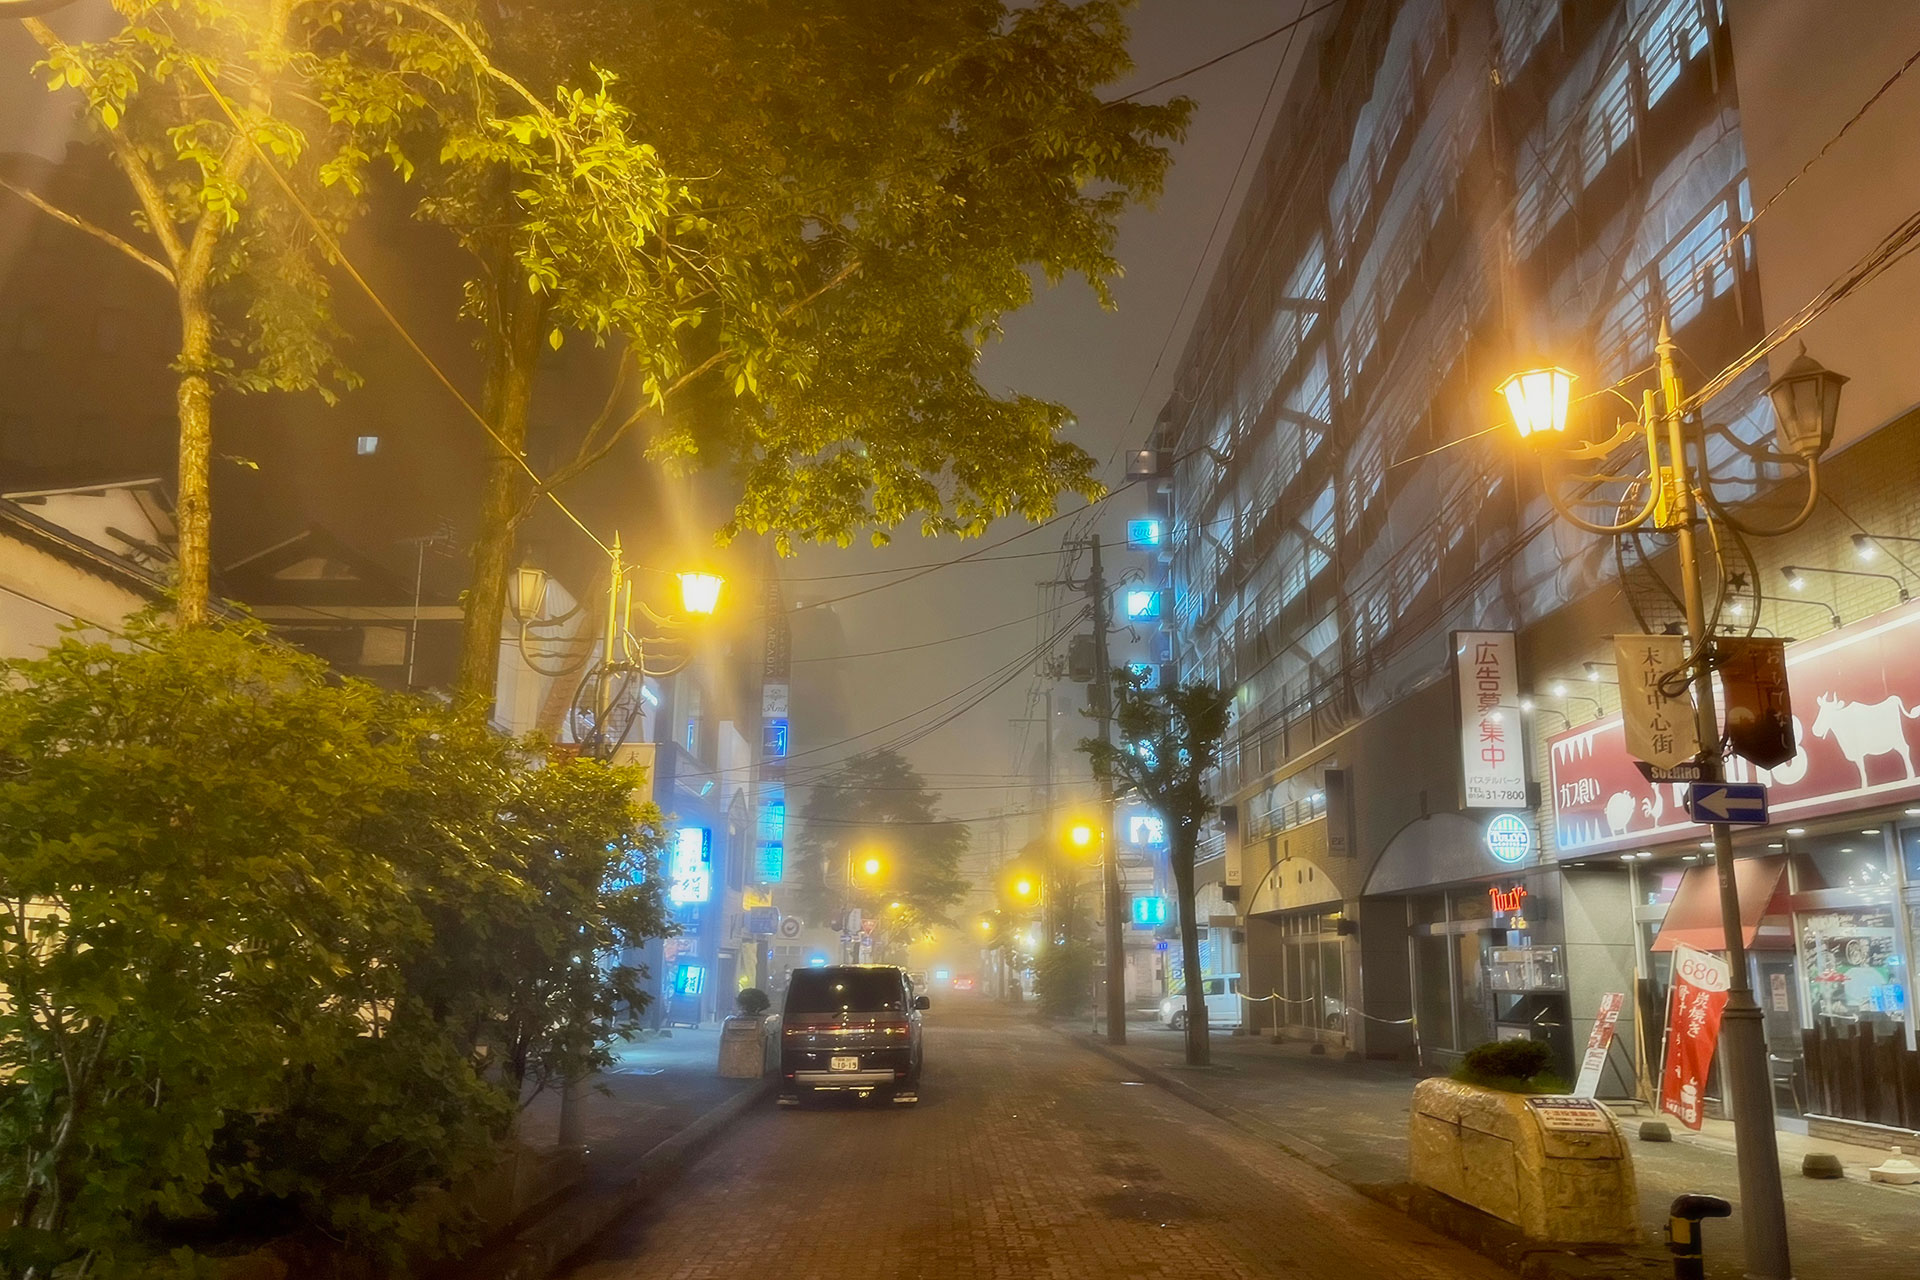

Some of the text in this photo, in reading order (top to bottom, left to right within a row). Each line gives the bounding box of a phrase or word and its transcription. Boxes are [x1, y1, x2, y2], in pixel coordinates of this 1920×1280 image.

[766, 625, 778, 675] ARCADIA
[1474, 641, 1505, 769] 広告募集中
[1641, 646, 1674, 755] 末広中心街
[1485, 790, 1525, 800] 31-7800
